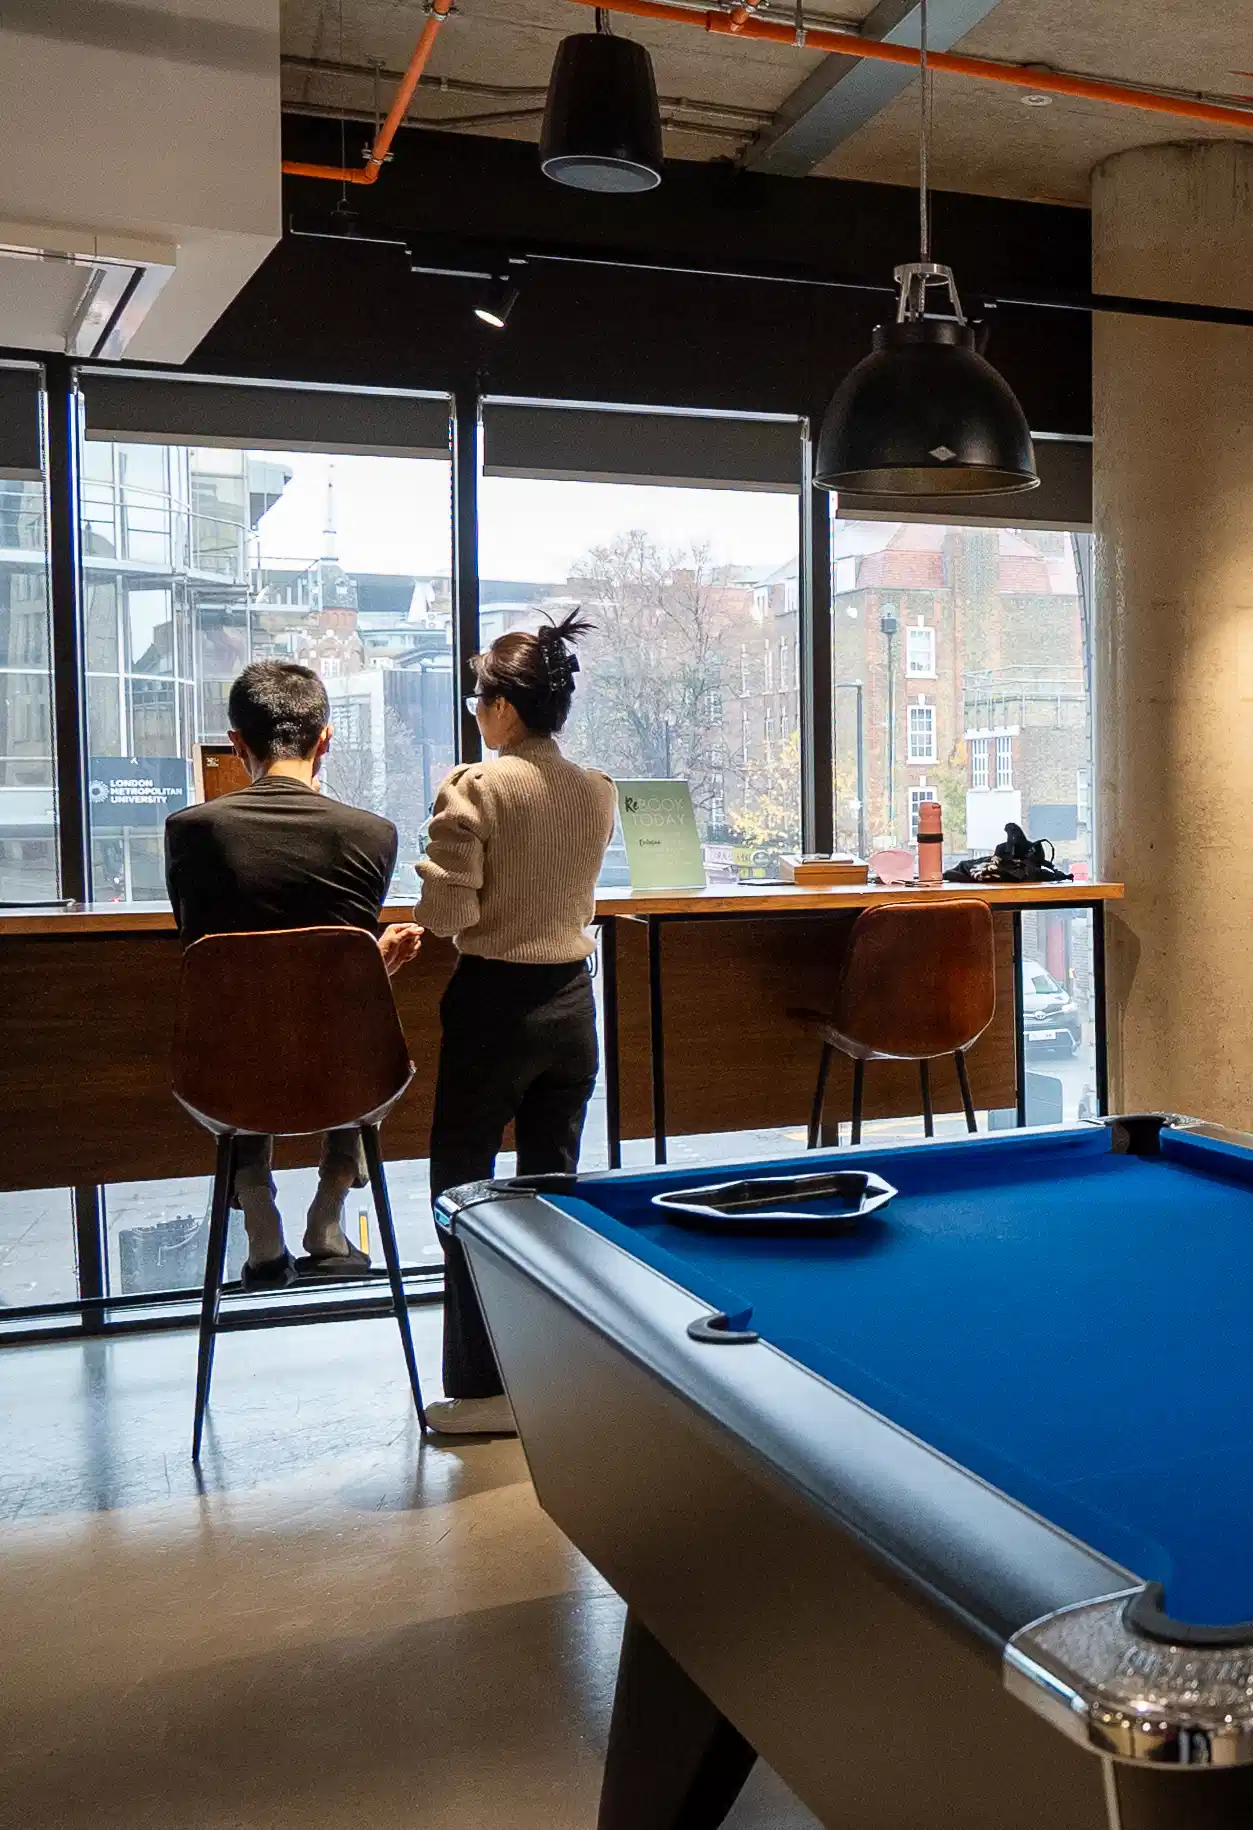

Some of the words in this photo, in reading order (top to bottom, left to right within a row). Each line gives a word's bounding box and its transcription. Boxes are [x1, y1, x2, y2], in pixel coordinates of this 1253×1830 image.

[110, 779, 153, 788] LONDON
[110, 787, 182, 796] METROPOLITAN
[110, 795, 167, 804] UNIVERSITY
[632, 813, 685, 827] TODAY
